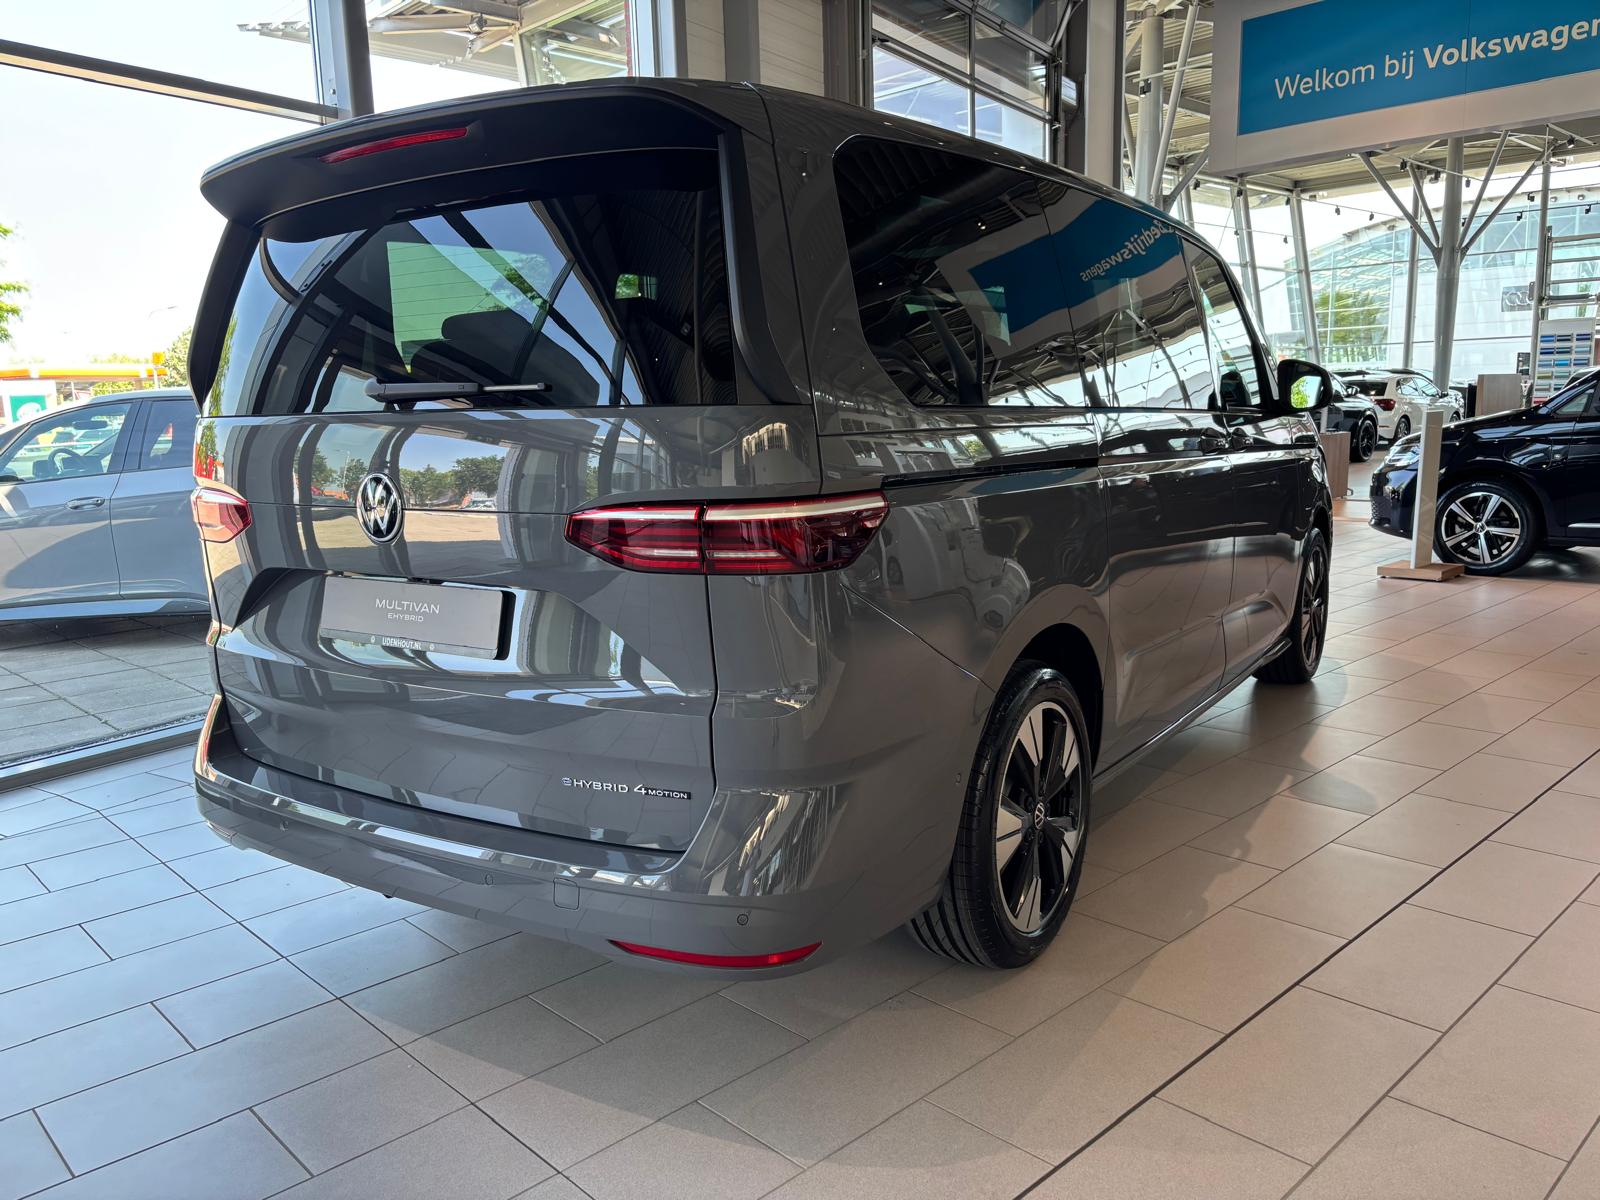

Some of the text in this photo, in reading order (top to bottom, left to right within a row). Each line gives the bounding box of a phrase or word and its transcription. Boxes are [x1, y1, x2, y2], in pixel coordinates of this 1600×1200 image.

[1274, 63, 1375, 99] Welkom
[1384, 50, 1415, 79] bij
[375, 598, 440, 614] MULTIVAN
[387, 612, 424, 622] EHYBRID
[382, 636, 422, 650] UDENHOUT.NL
[633, 784, 688, 799] 4MOTION
